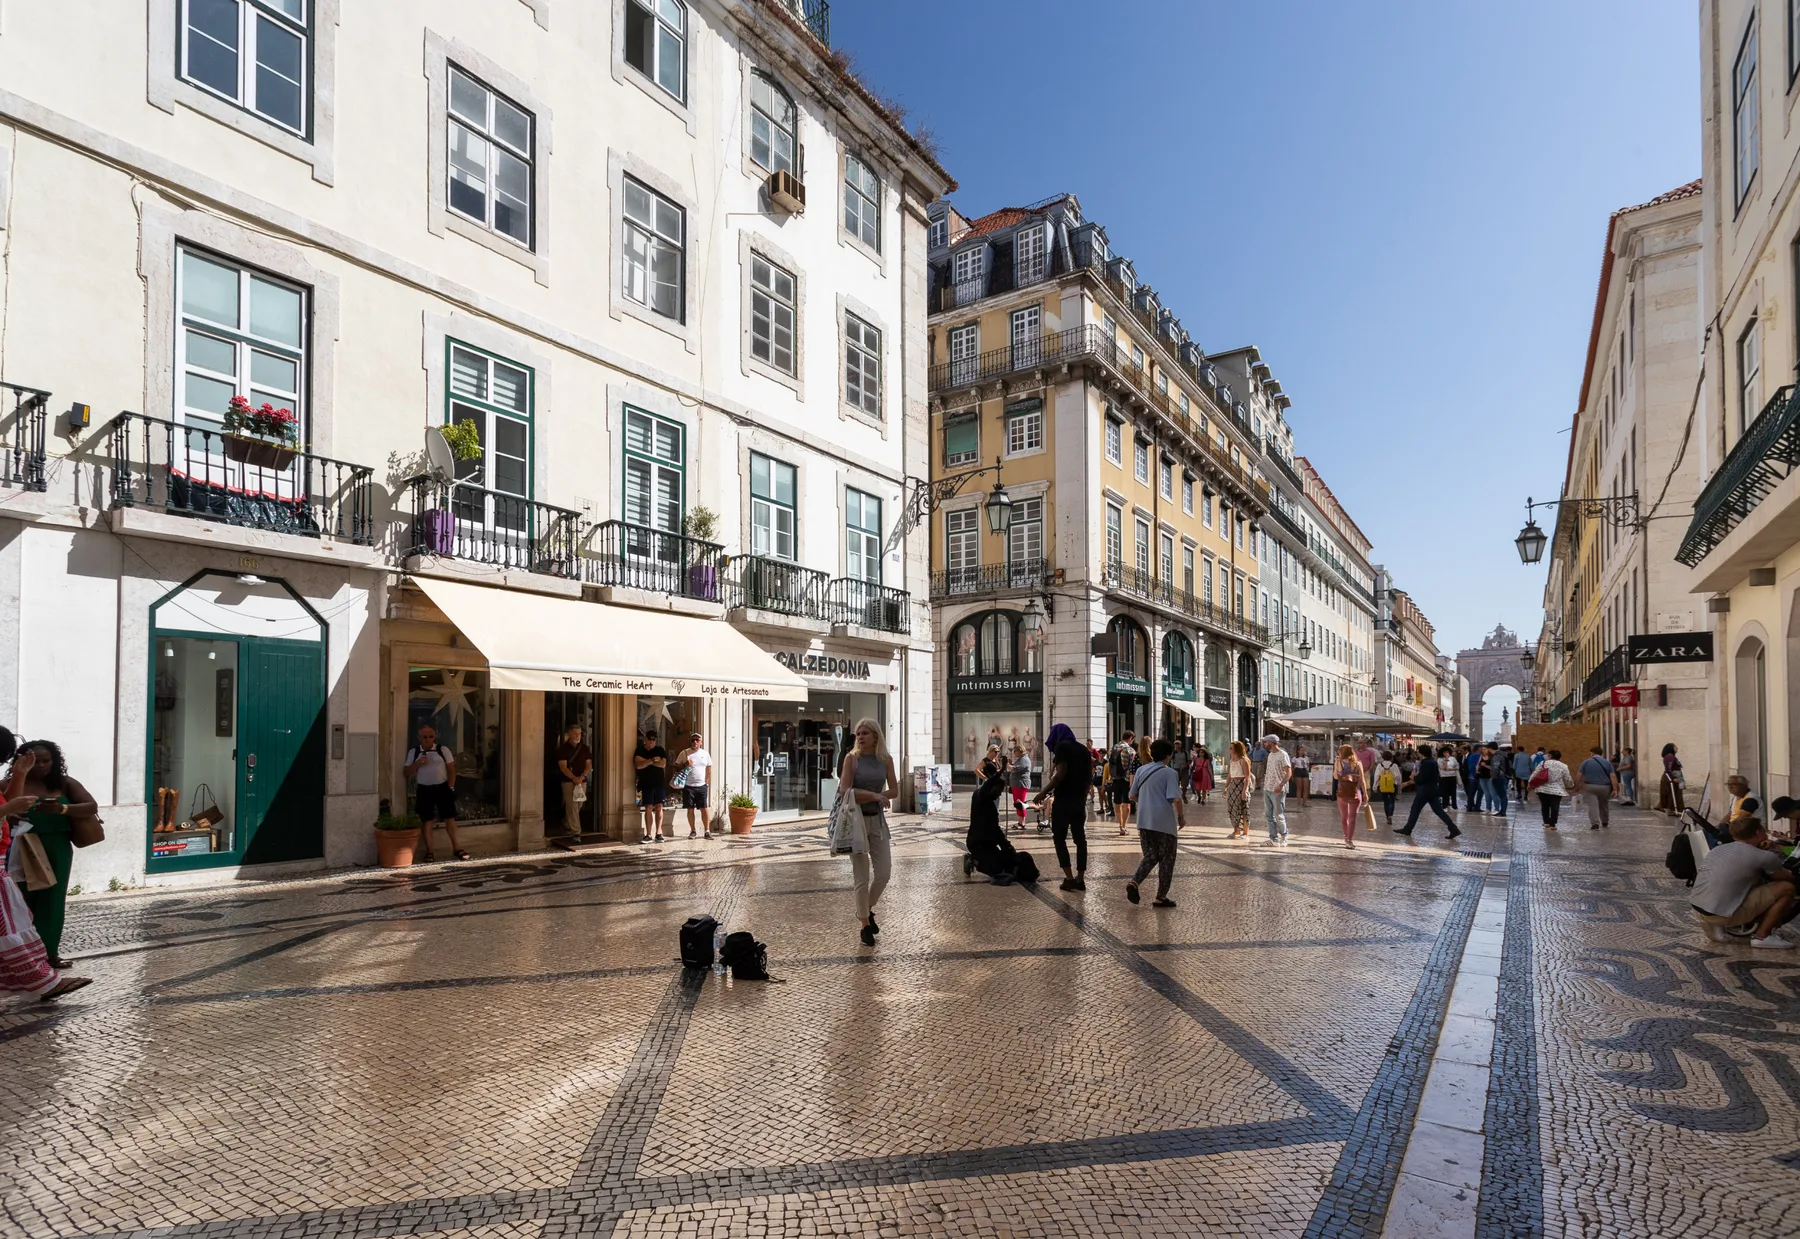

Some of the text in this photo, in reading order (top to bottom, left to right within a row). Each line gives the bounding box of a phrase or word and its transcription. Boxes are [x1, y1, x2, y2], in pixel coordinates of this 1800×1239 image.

[1635, 646, 1707, 658] ZARA
[775, 651, 871, 677] CALZEDONIA
[562, 677, 769, 696] The Ceramic HeArt Loja de Artesanato
[957, 680, 1031, 690] intimissimi
